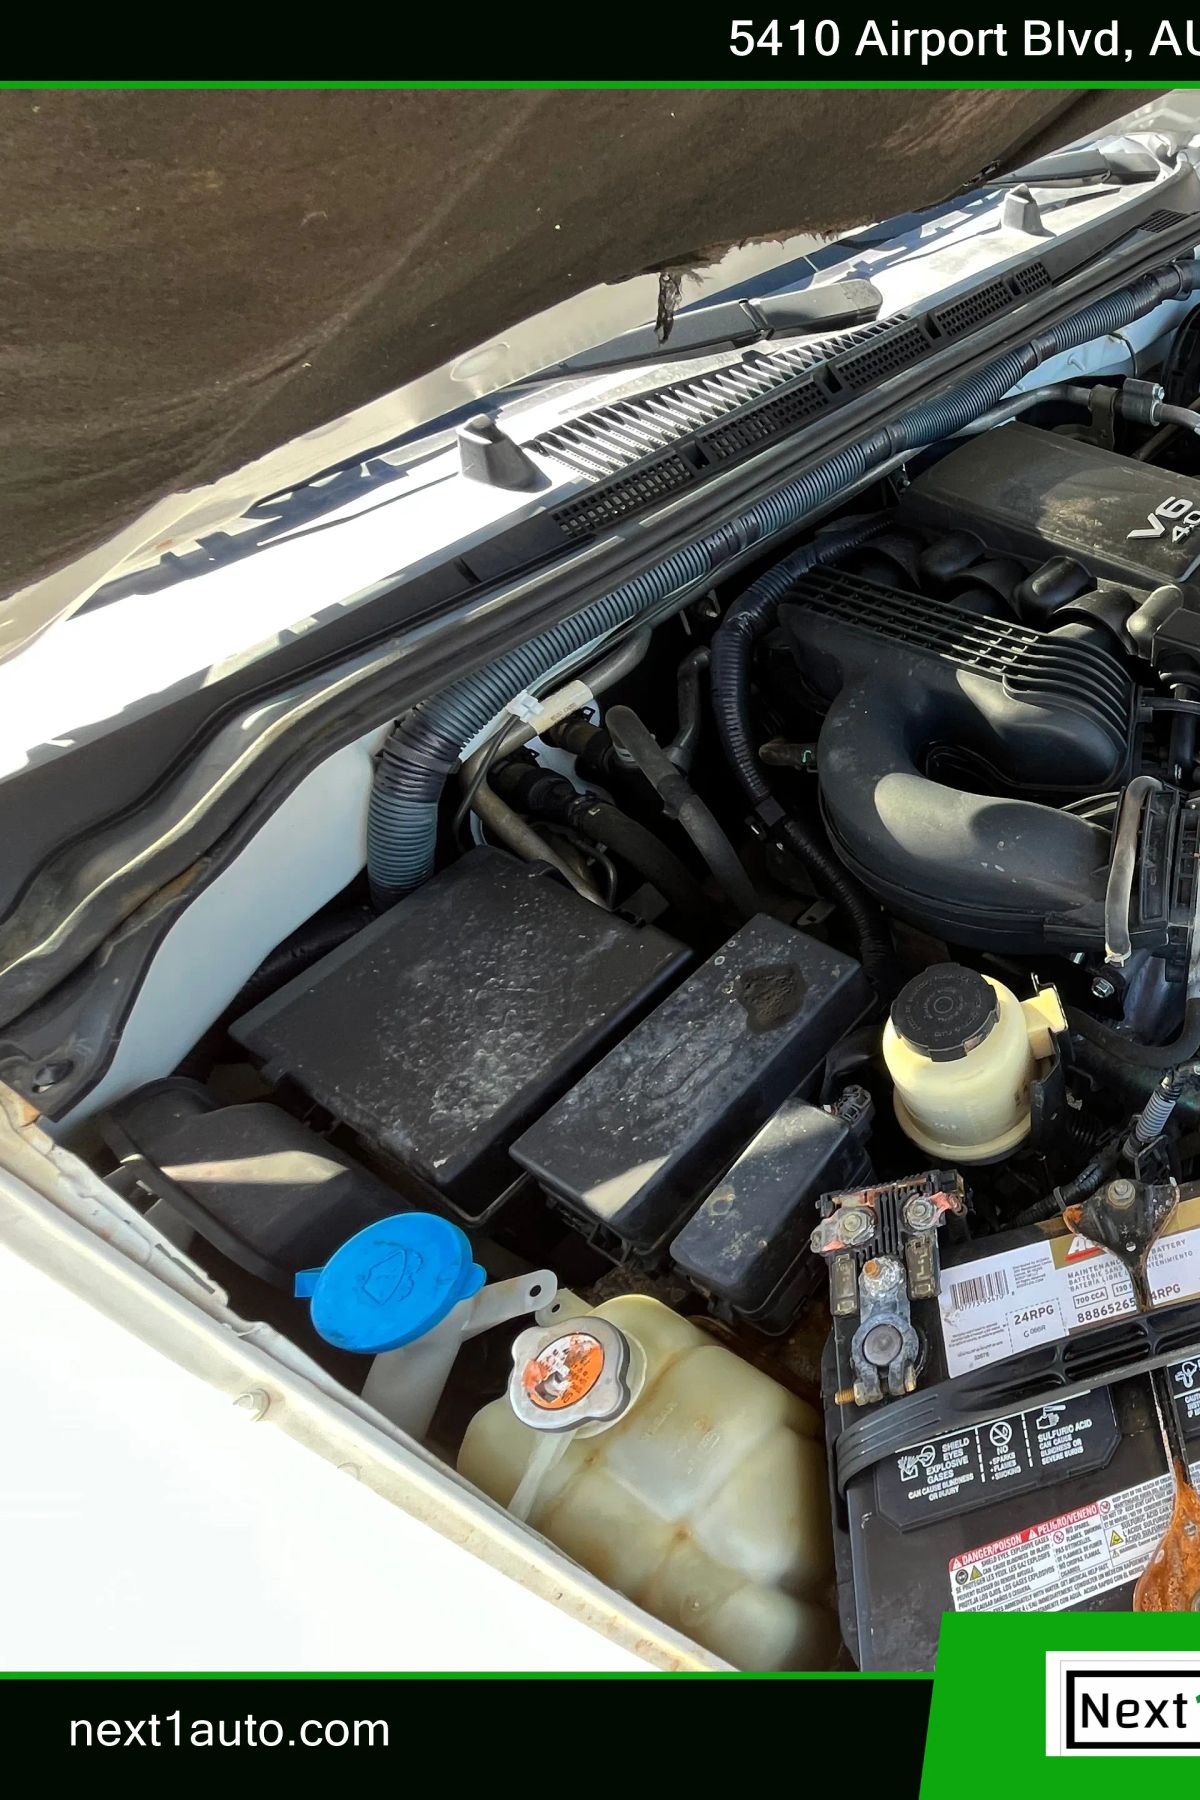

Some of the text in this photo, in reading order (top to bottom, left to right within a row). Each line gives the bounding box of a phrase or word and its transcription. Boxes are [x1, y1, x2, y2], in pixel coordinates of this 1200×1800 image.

[1127, 496, 1193, 539] V6
[1151, 1238, 1186, 1254] BATTERY
[1075, 1295, 1089, 1304] 700
[1090, 1290, 1105, 1300] CCA
[1013, 1304, 1054, 1325] 24RPG
[1076, 1297, 1136, 1323] 88865265
[1037, 1418, 1092, 1442] SULFURIC ACID
[941, 1436, 970, 1453] SHIELD
[996, 1444, 1009, 1455] NO
[1038, 1433, 1072, 1449] CAN CAUSE
[1040, 1437, 1082, 1457] BLINDNESS OR
[942, 1447, 964, 1461] EYES
[1041, 1445, 1084, 1465] SEVERE BURNS
[925, 1454, 969, 1475] EXPLOSIVE
[907, 1472, 974, 1499] CAN CAUSE BLINDNESS
[926, 1468, 954, 1484] GASES
[927, 1484, 960, 1501] OR INJURY
[962, 1504, 1097, 1565] DANGER/POISON PELIGRO/VENENO
